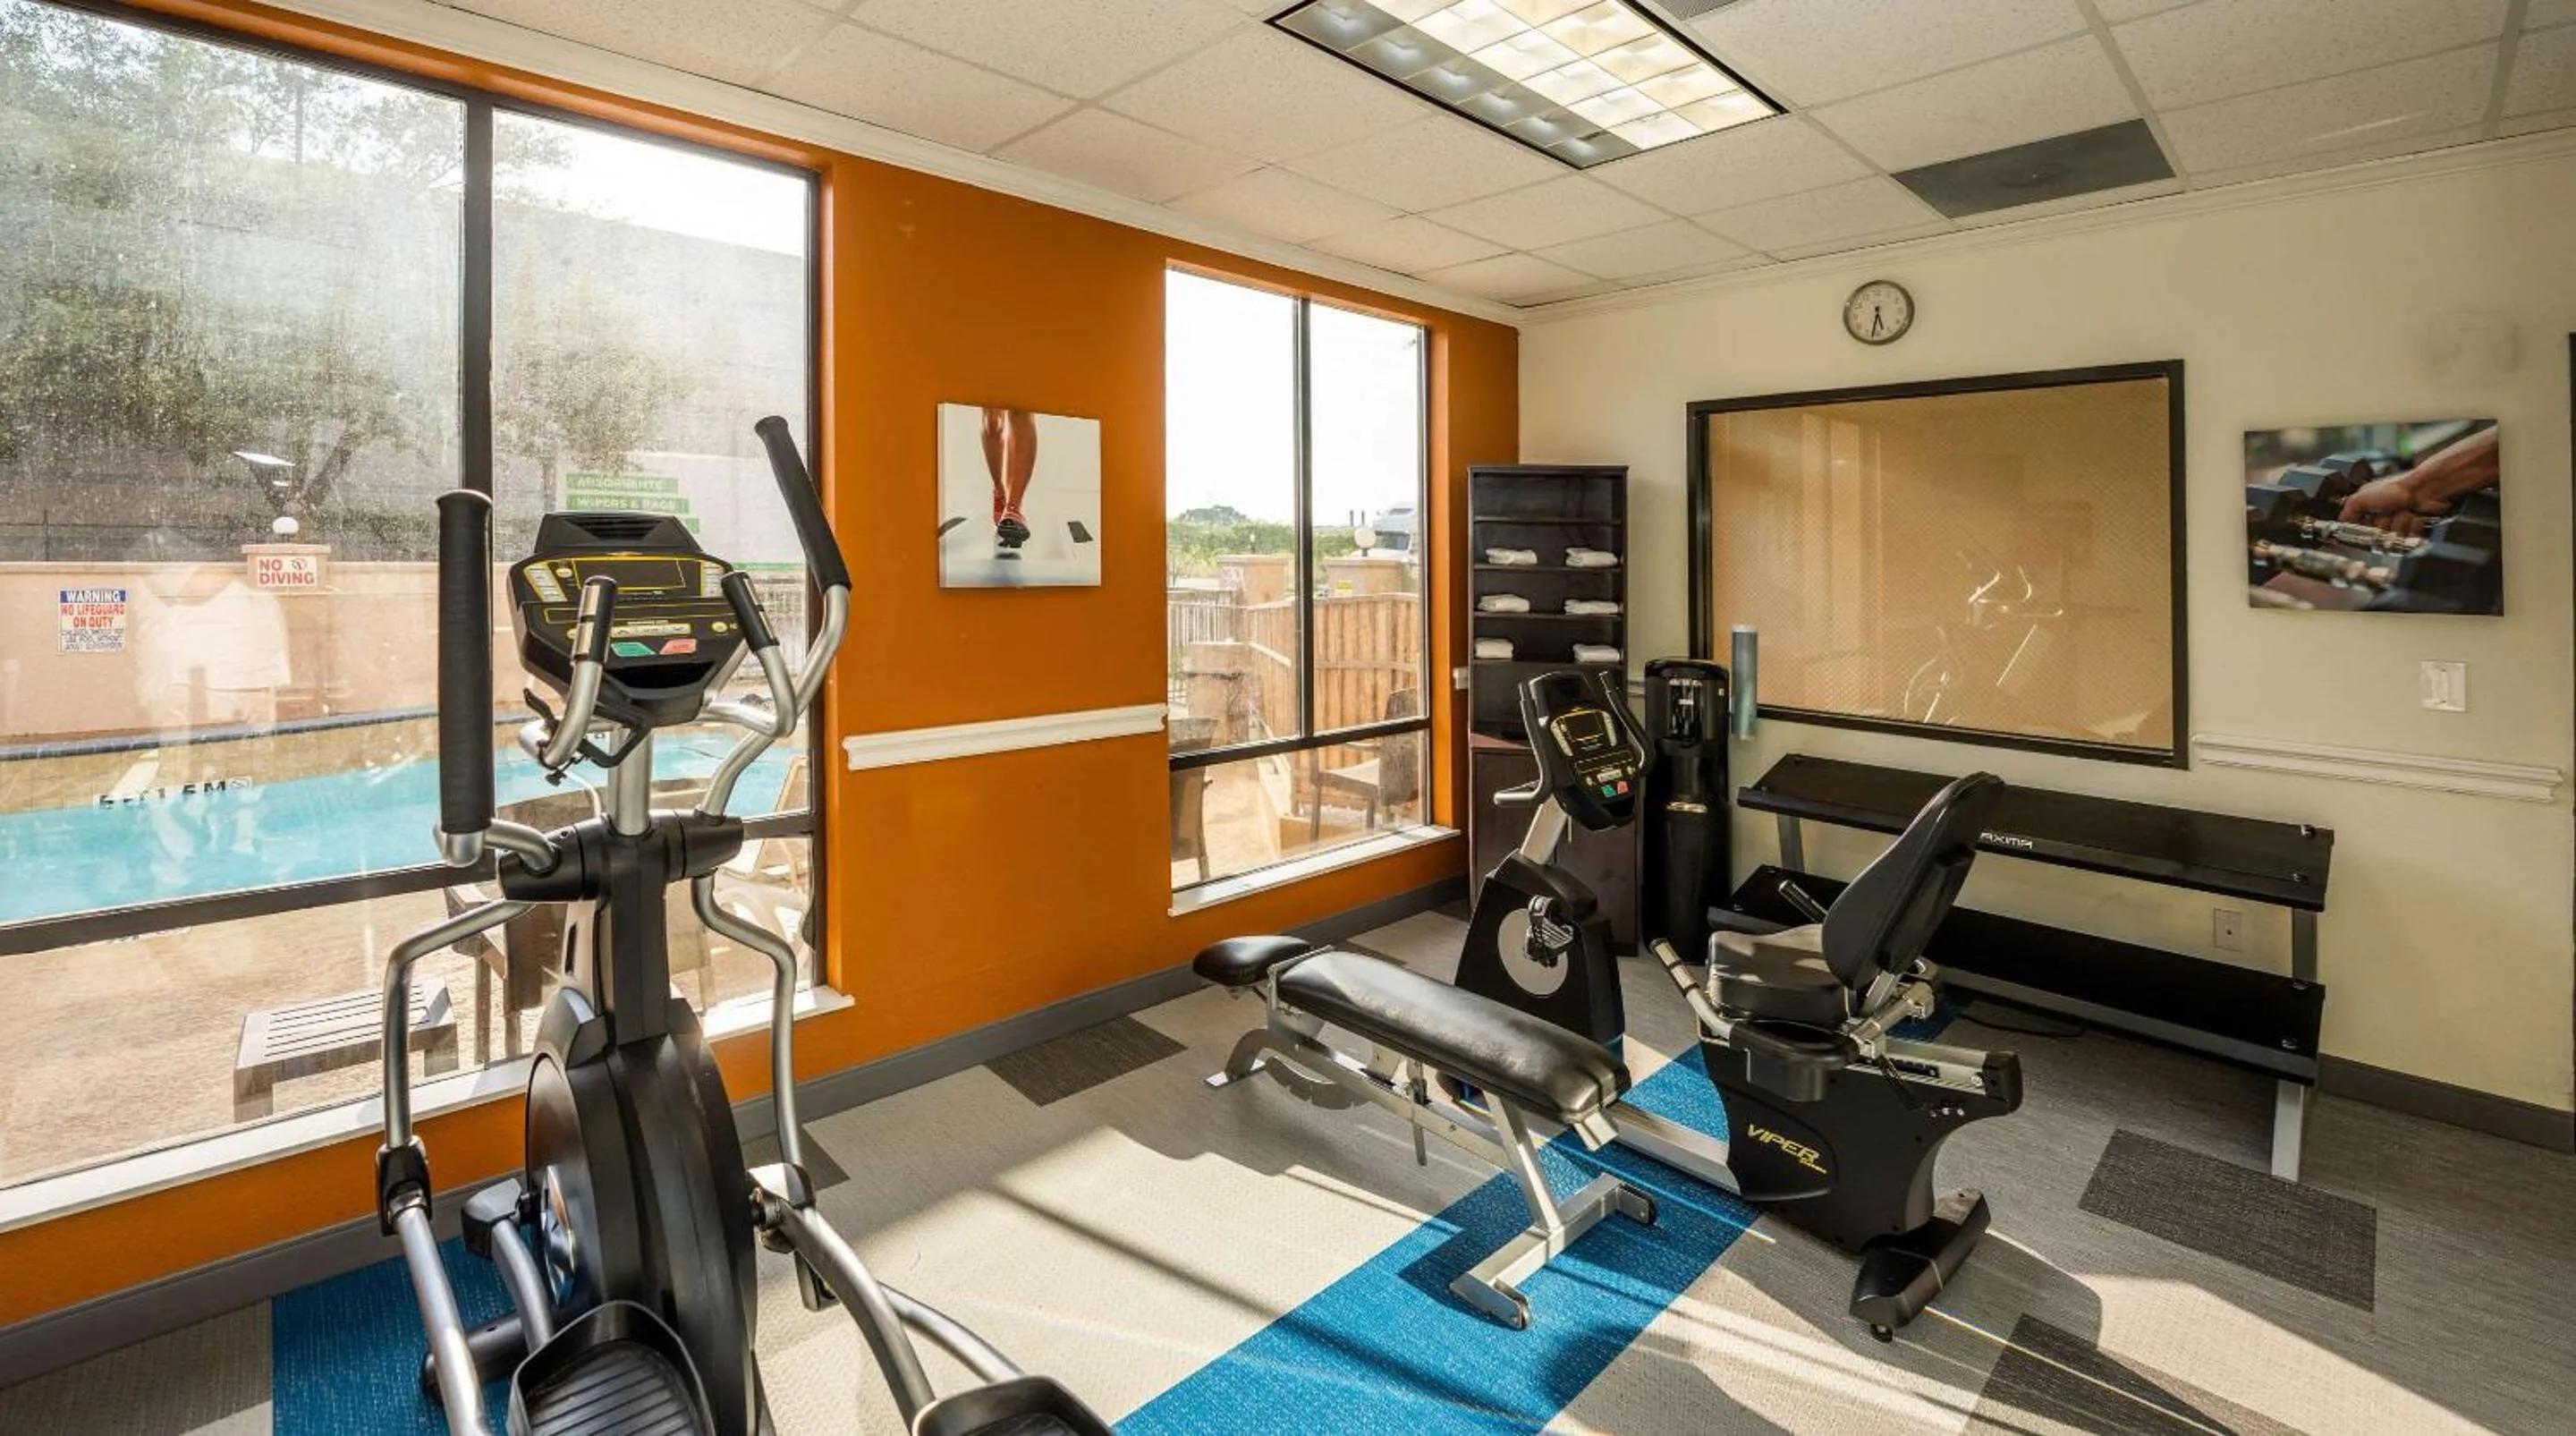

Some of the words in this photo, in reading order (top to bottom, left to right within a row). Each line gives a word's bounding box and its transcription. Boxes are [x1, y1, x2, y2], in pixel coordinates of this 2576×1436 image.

[258, 558, 283, 572] NO
[258, 572, 315, 585] DIVING
[66, 591, 121, 603] WARNING
[61, 603, 75, 616] NO
[77, 603, 125, 616] LIFEGUARD
[72, 616, 87, 628] ON
[89, 616, 114, 628] DUTY
[1748, 1124, 1819, 1164] VIPER
